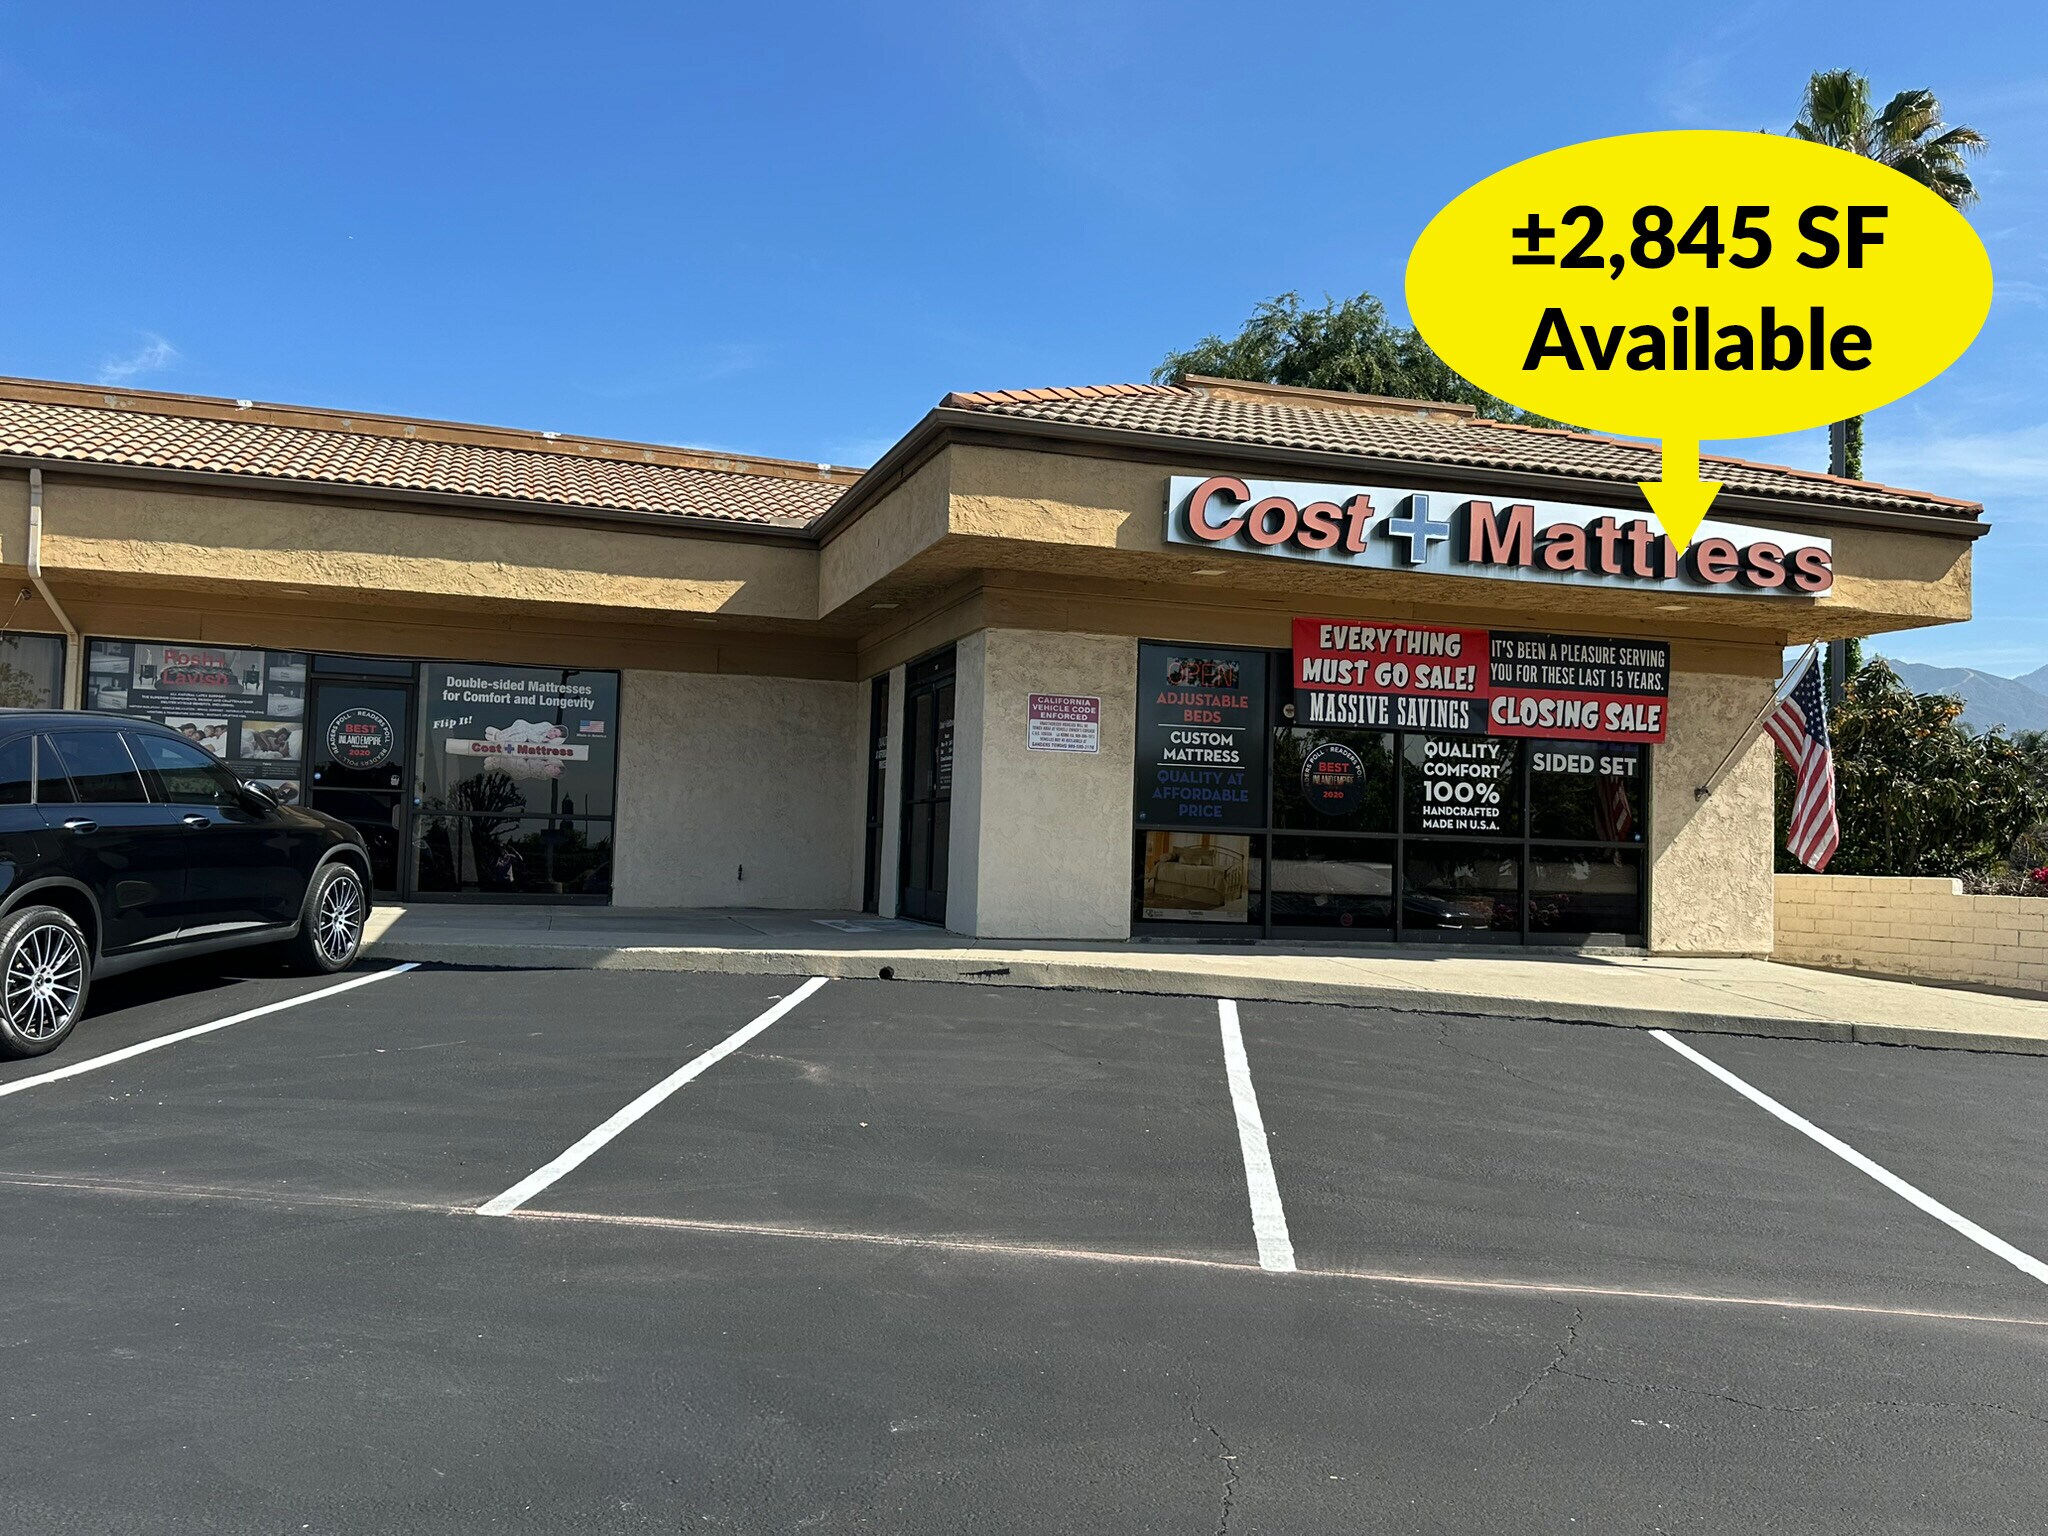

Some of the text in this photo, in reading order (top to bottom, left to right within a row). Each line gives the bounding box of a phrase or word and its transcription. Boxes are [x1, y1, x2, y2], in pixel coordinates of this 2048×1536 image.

[1186, 474, 1374, 554] Cost
[1319, 624, 1462, 658] EVERYTHING
[1491, 639, 1665, 668] IT'S BEEN A PLEASURE SERVING
[161, 669, 229, 687] Lavish
[1168, 661, 1233, 687] OPEN
[1302, 657, 1477, 691] MUST GO SALE!
[1490, 662, 1664, 691] YOU FOR THESE LAST 15 YEARS.
[446, 676, 592, 695] Double-sided Mattresses
[442, 689, 595, 711] for Comfort and Longevity
[1038, 697, 1091, 706] CALIFORNIA
[1156, 692, 1249, 708] ADJUSTABLE
[1032, 704, 1096, 714] VEHICLE CODE
[1040, 712, 1087, 720] ENFORCED
[1183, 709, 1222, 724] BEDS
[1309, 692, 1470, 730] MASSIVE SAVINGS
[1491, 696, 1662, 733] CLOSING SALE
[345, 723, 377, 733] BEST
[357, 711, 391, 743] READERS POLL
[432, 715, 473, 729] Flip It!
[329, 713, 352, 754] READERS POLL
[338, 734, 382, 746] INLAND EMPIRE
[1170, 731, 1234, 746] CUSTOM
[471, 742, 502, 753] Cost
[517, 744, 574, 757] Mattress
[1163, 747, 1240, 763] MATTRESS
[1309, 749, 1325, 764] POLL
[1329, 746, 1358, 765] READERS
[1423, 741, 1500, 759] QUALITY
[1318, 762, 1350, 773] BEST
[1423, 762, 1500, 779] COMFORT
[1532, 752, 1637, 776] SIDED SET
[1157, 769, 1245, 785] QUALITY AT
[1152, 786, 1249, 802] AFFORDABLE
[1323, 791, 1344, 799] 2020
[1423, 780, 1500, 804] 100%
[1178, 803, 1223, 817] PRICE
[1422, 805, 1500, 818] HANDCRAFTED
[1422, 819, 1500, 830] MADE IN U.S.A.
